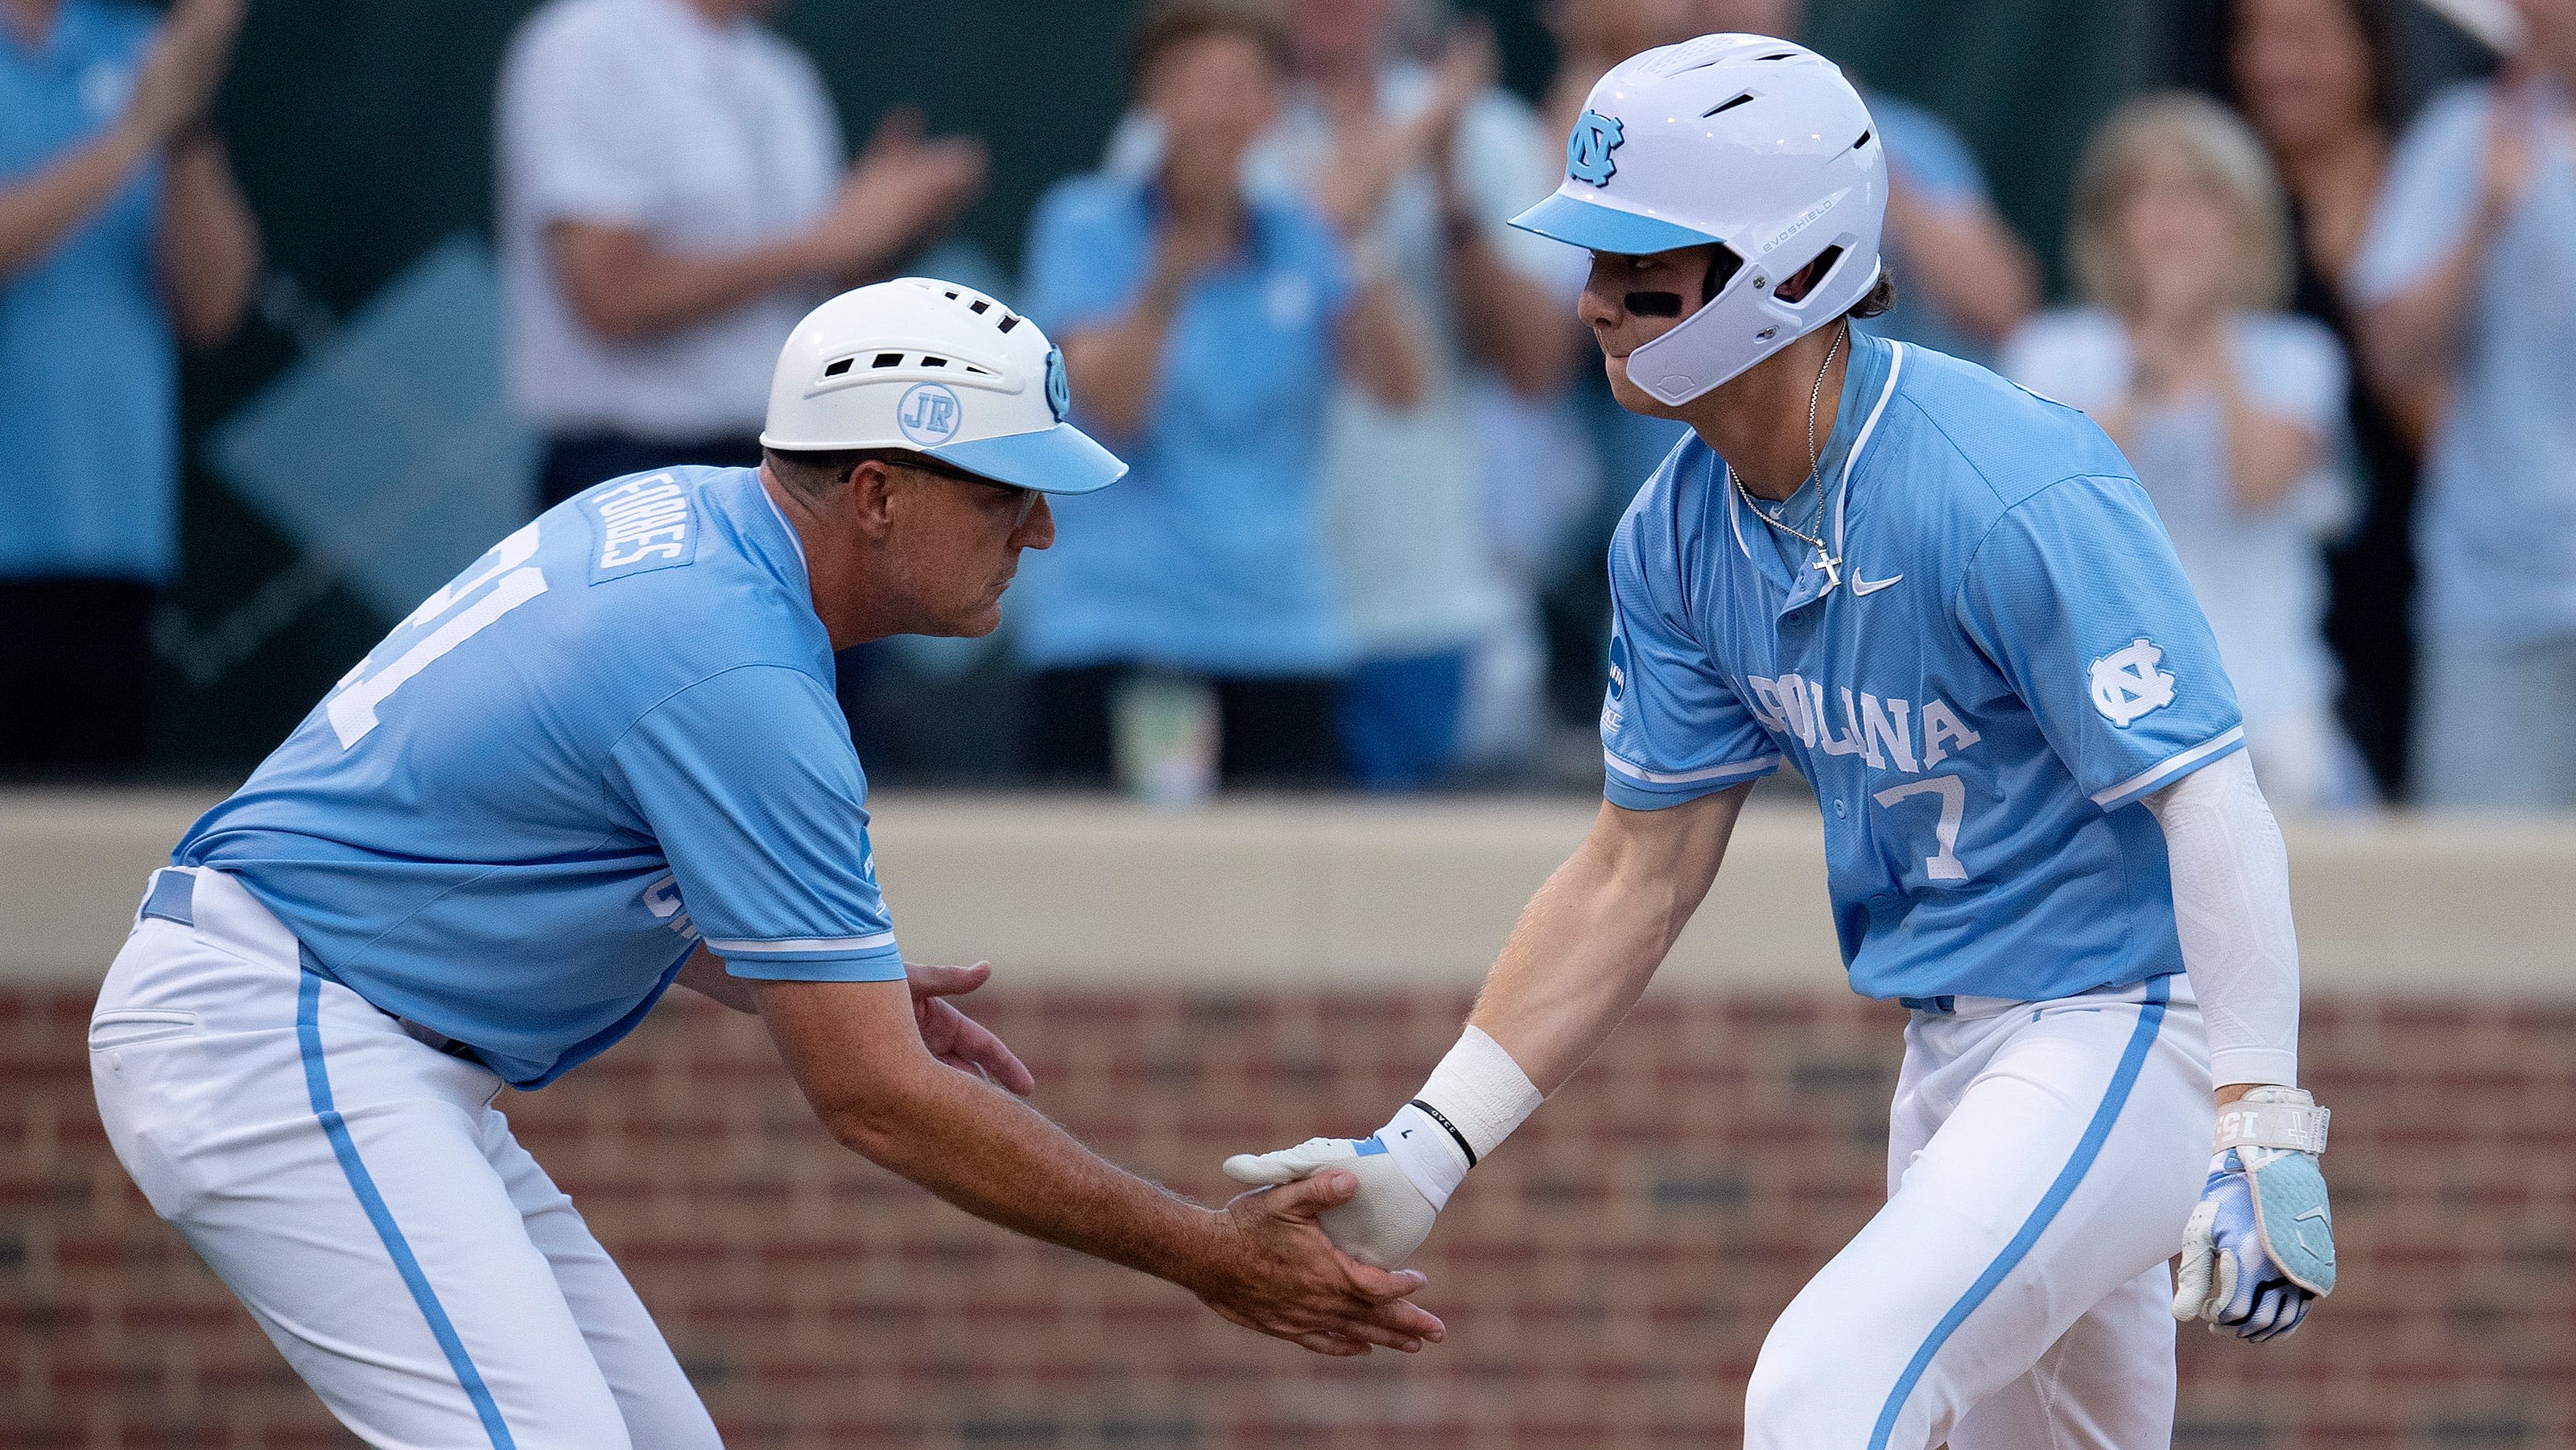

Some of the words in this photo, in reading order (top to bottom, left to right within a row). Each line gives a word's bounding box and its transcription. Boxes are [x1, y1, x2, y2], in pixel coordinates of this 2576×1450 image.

[904, 391, 955, 434] JR
[592, 472, 688, 569] FORBES
[1731, 673, 1981, 773] ROLINA
[1872, 775, 1969, 881] 7
